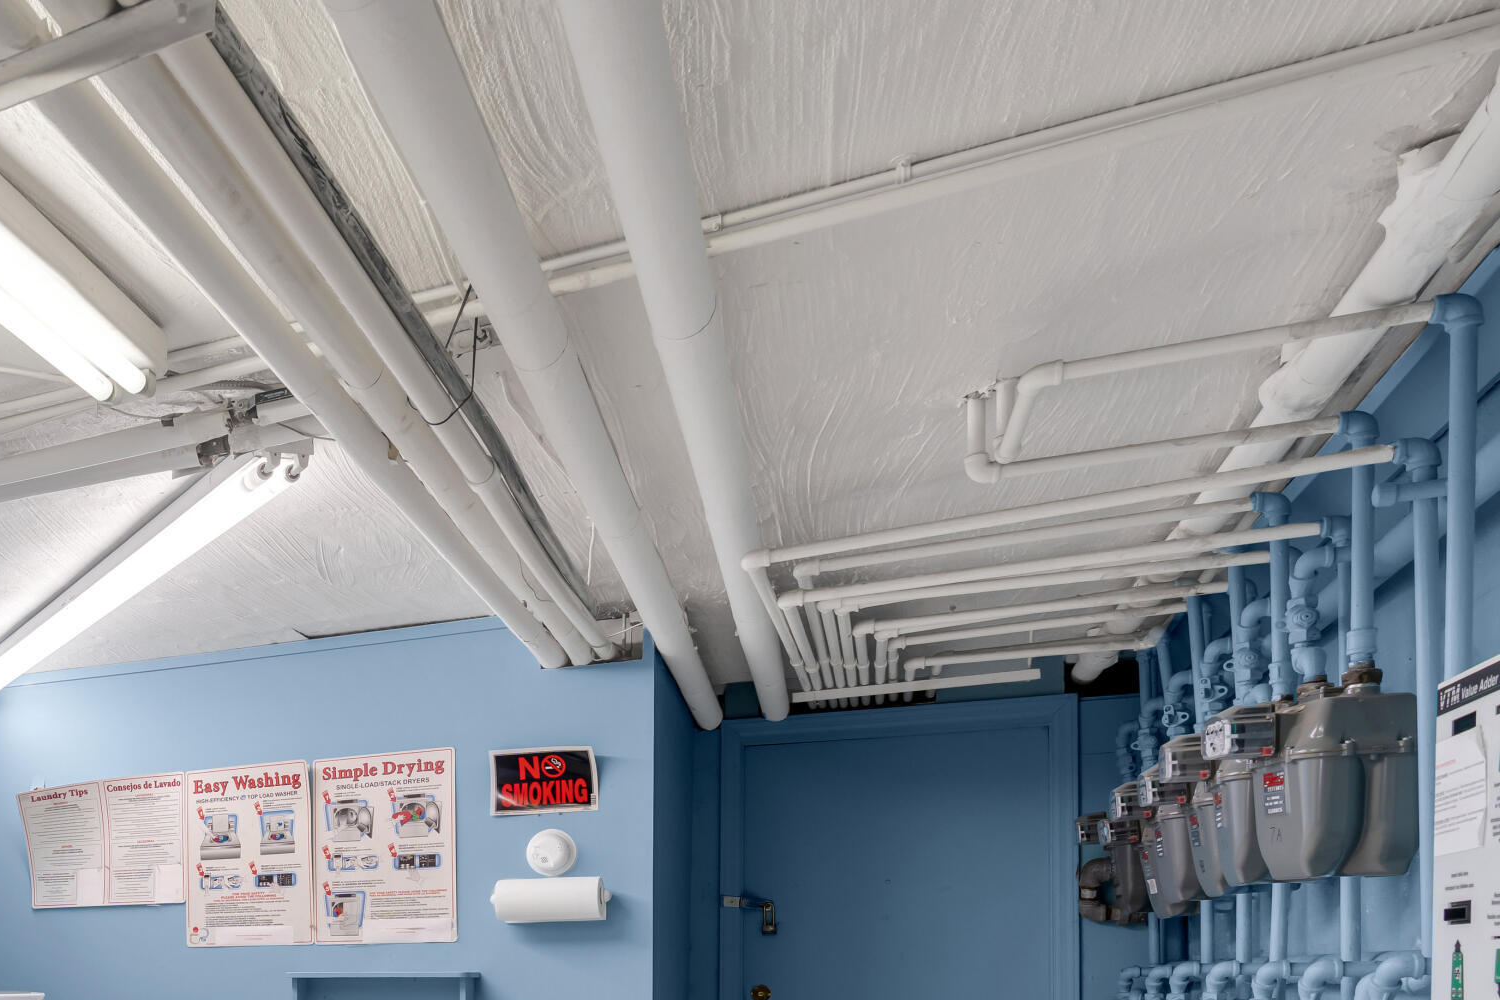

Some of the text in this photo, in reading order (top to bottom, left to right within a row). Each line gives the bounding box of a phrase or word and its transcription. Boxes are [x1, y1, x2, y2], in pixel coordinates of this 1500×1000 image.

[1439, 674, 1499, 711] VTM Value Adder
[322, 758, 445, 782] Simple Drying
[518, 754, 567, 781] NO
[106, 778, 181, 793] Consejos de Lavado
[193, 772, 302, 797] Easy Washing
[403, 777, 430, 785] DRYERS
[501, 778, 589, 808] SMOKING
[30, 787, 89, 803] Laundry Tips
[274, 790, 298, 798] WASHER
